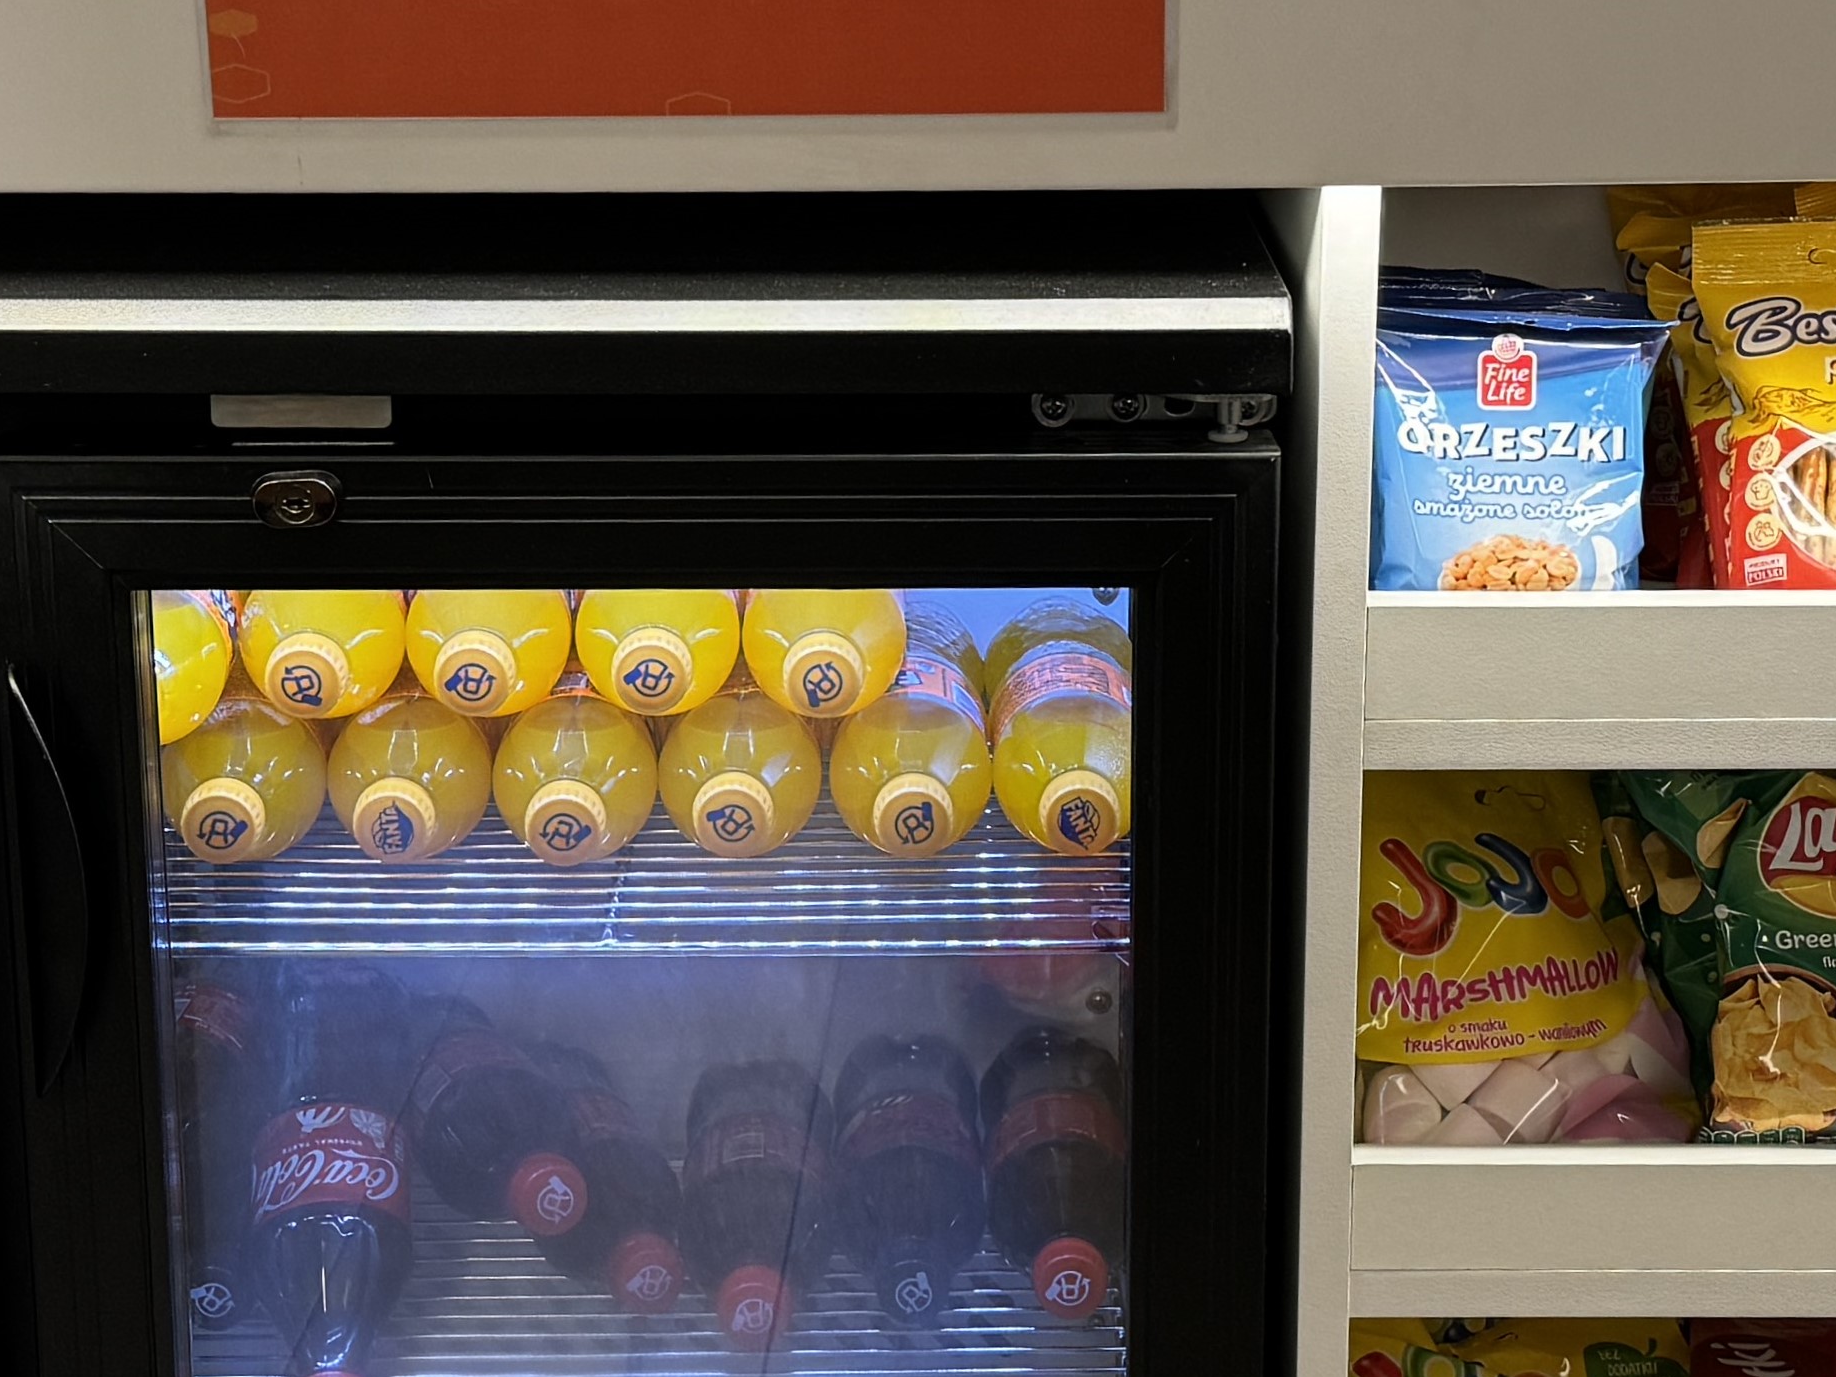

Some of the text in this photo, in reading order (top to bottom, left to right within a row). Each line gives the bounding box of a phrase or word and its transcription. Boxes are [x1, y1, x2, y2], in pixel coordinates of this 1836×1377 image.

[1485, 362, 1531, 384] Fine
[1486, 382, 1526, 402] Life
[1397, 420, 1627, 463] ORZESZKI
[1447, 467, 1568, 501] ziemne
[1368, 943, 1621, 1024] MARSHMALLOW
[1460, 1017, 1510, 1036] smaku
[1401, 1029, 1527, 1056] truskawkowo
